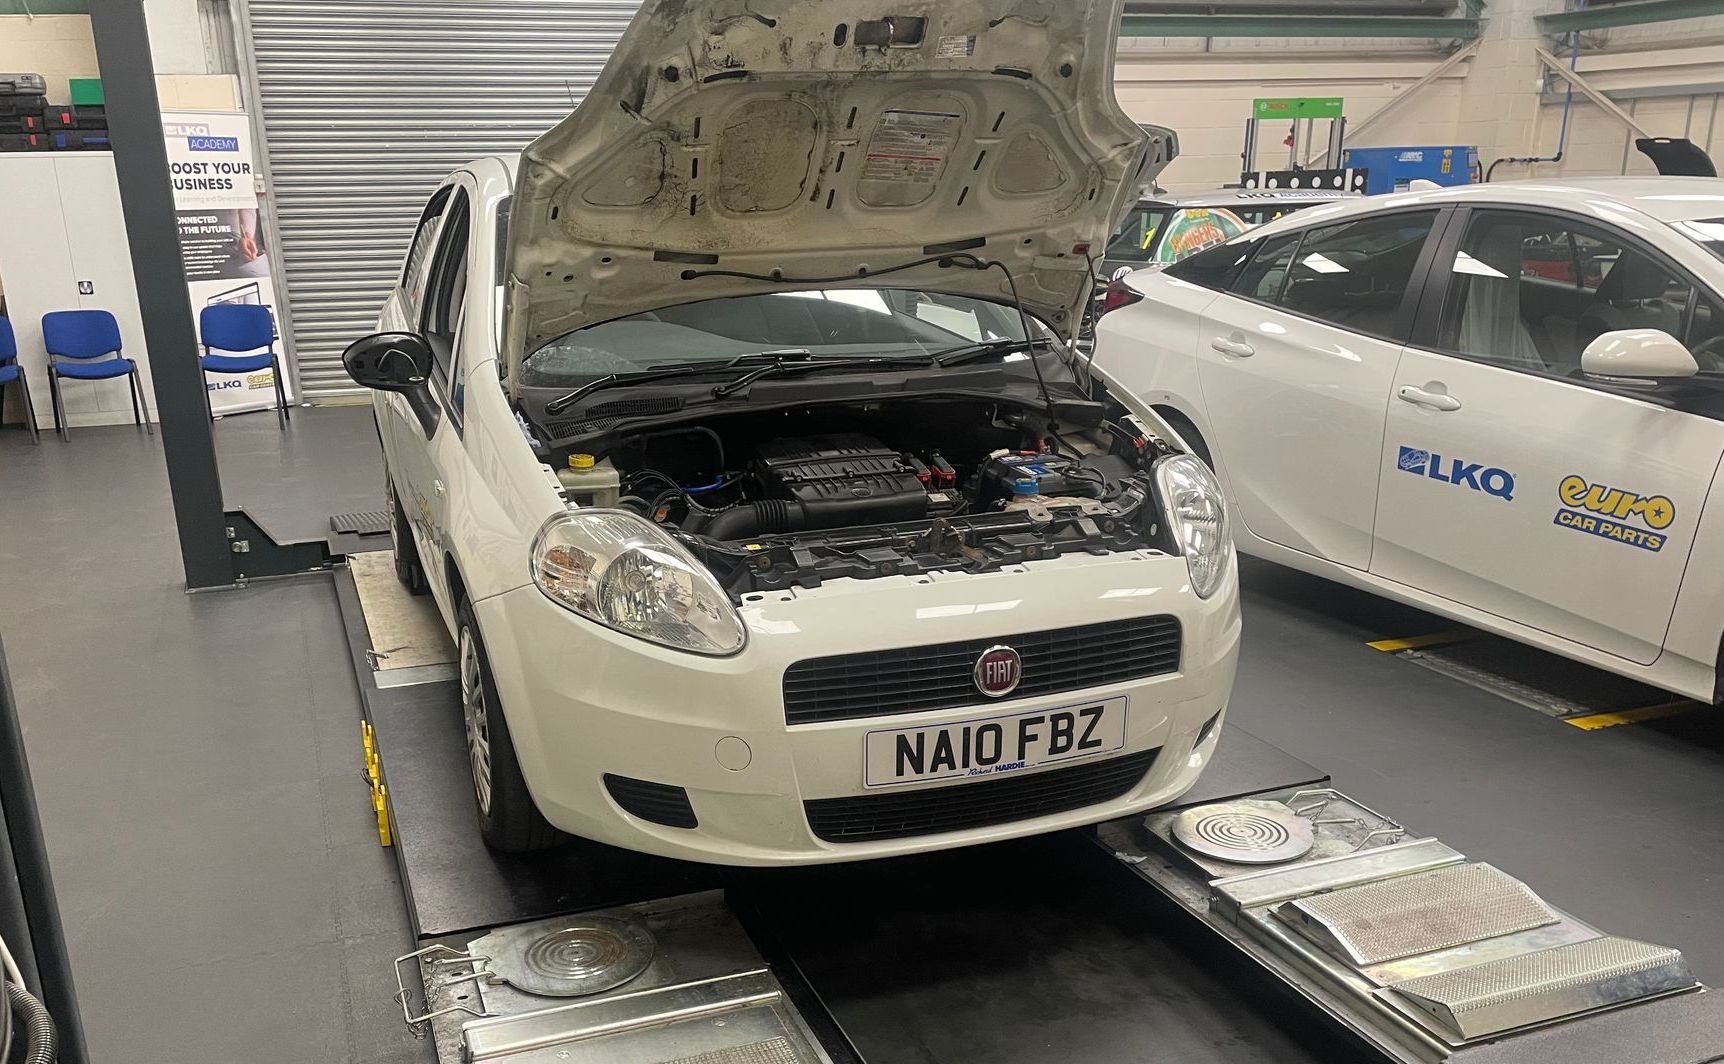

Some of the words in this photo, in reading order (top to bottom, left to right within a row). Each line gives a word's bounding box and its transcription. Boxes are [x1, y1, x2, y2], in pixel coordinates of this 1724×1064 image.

[190, 138, 236, 149] ACADEMY
[171, 162, 208, 174] OOST
[212, 162, 250, 174] YOUR
[173, 178, 233, 190] USINESS
[200, 225, 232, 234] FUTURE
[217, 380, 242, 389] LKQ
[1429, 454, 1515, 502] LKQ
[1559, 475, 1676, 530] euro
[1558, 512, 1597, 531] CAR
[1599, 522, 1662, 549] PARTS
[986, 659, 1013, 685] FIAT
[895, 723, 1003, 777] NA10
[1018, 706, 1105, 761] FBZ
[995, 761, 1026, 772] HARDIE
